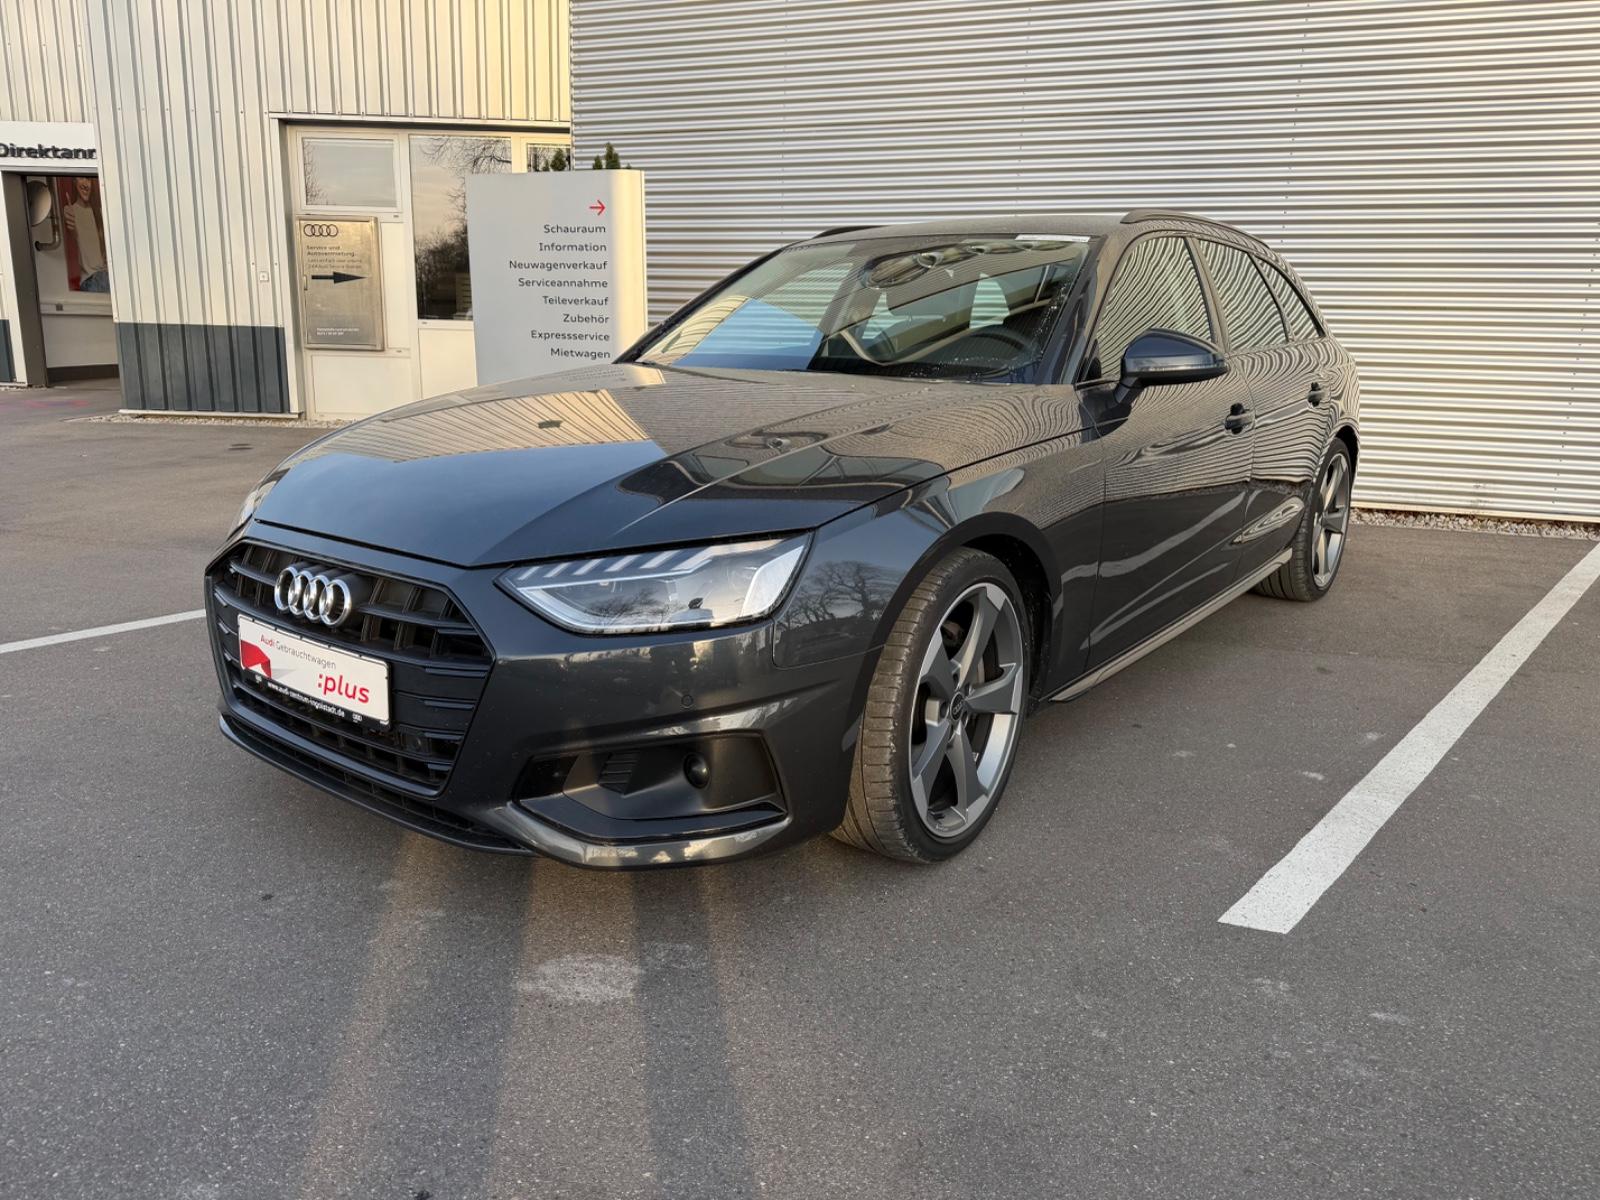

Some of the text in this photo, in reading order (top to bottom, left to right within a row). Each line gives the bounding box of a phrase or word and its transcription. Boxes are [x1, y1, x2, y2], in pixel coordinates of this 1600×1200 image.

[543, 224, 606, 234] Schauraum
[538, 242, 607, 252] Information
[509, 260, 608, 272] Neuwagenverkauf
[518, 277, 609, 288] Serviceannahme
[542, 295, 609, 306] Teileverkauf
[562, 312, 610, 324] Zubehör
[530, 329, 610, 341] Expressservice
[550, 347, 611, 361] Mietwagen
[260, 633, 337, 670] Audi Gebrauchtwagen
